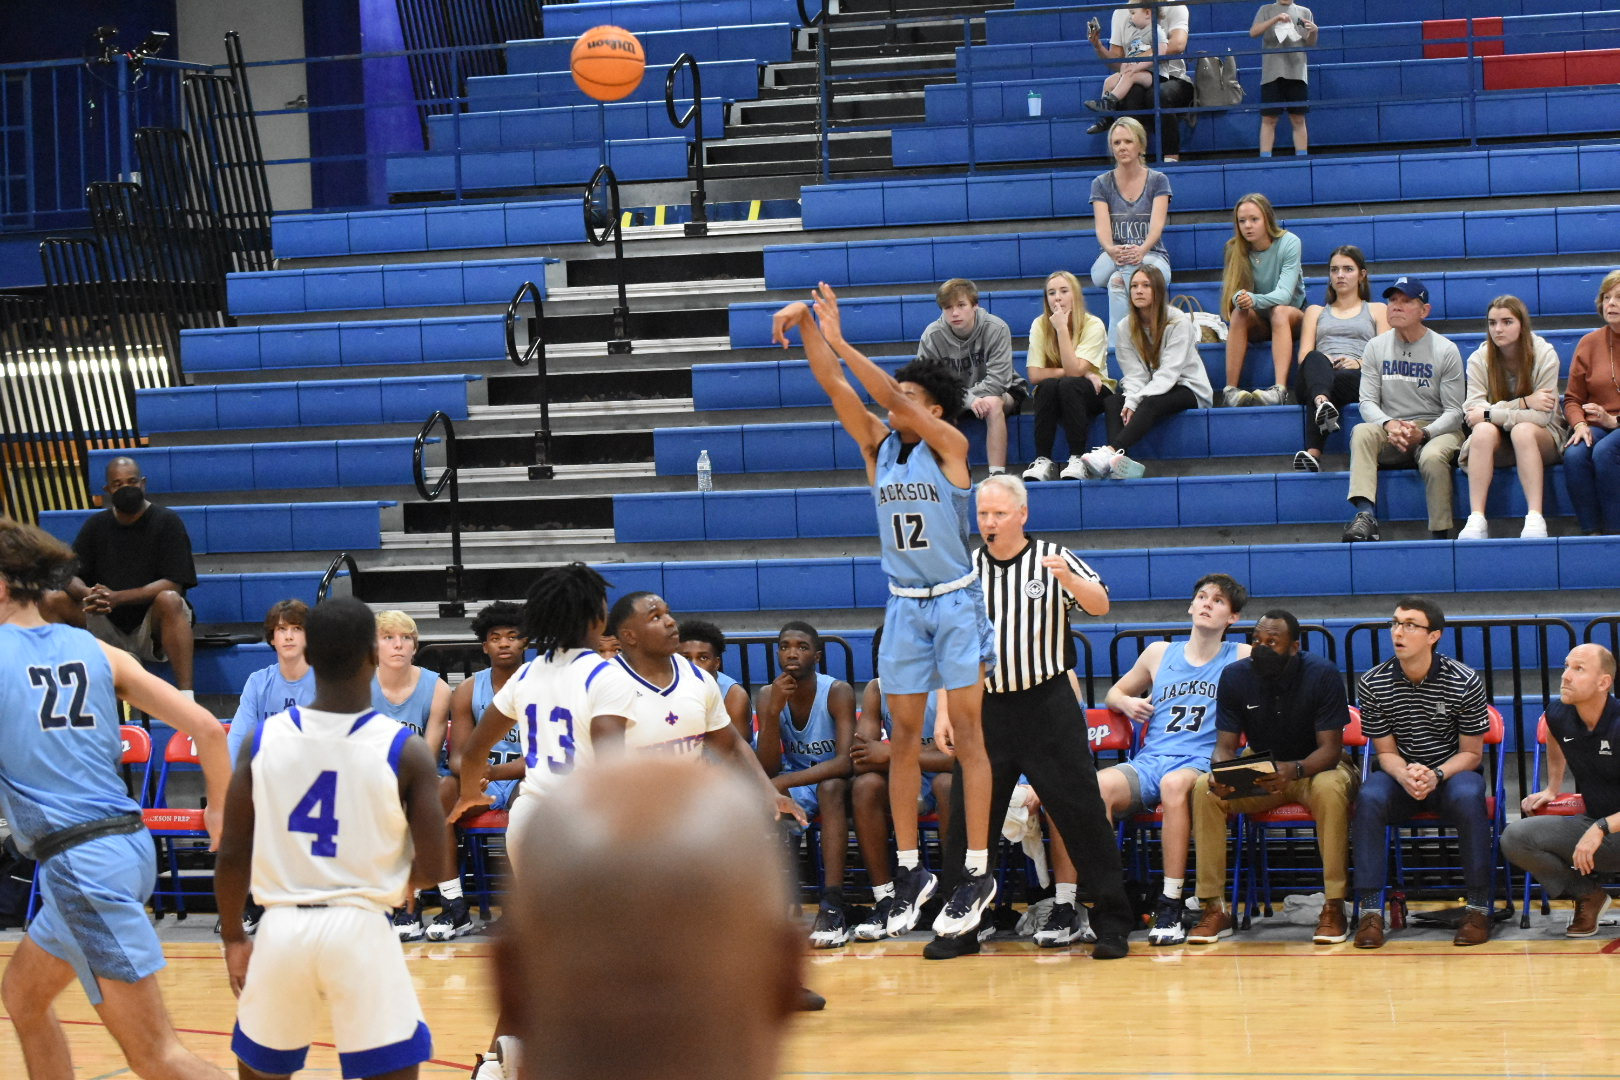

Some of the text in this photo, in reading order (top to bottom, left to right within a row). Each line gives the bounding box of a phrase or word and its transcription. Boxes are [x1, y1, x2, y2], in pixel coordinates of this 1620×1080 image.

[1382, 359, 1433, 379] RAIDERS
[878, 482, 941, 507] ACKSON
[891, 512, 930, 552] 12
[26, 659, 97, 732] 22
[1159, 680, 1218, 702] JACKSO
[1164, 705, 1207, 734] 23
[524, 703, 576, 776] 13
[1087, 724, 1111, 746] ep
[287, 770, 339, 858] 4
